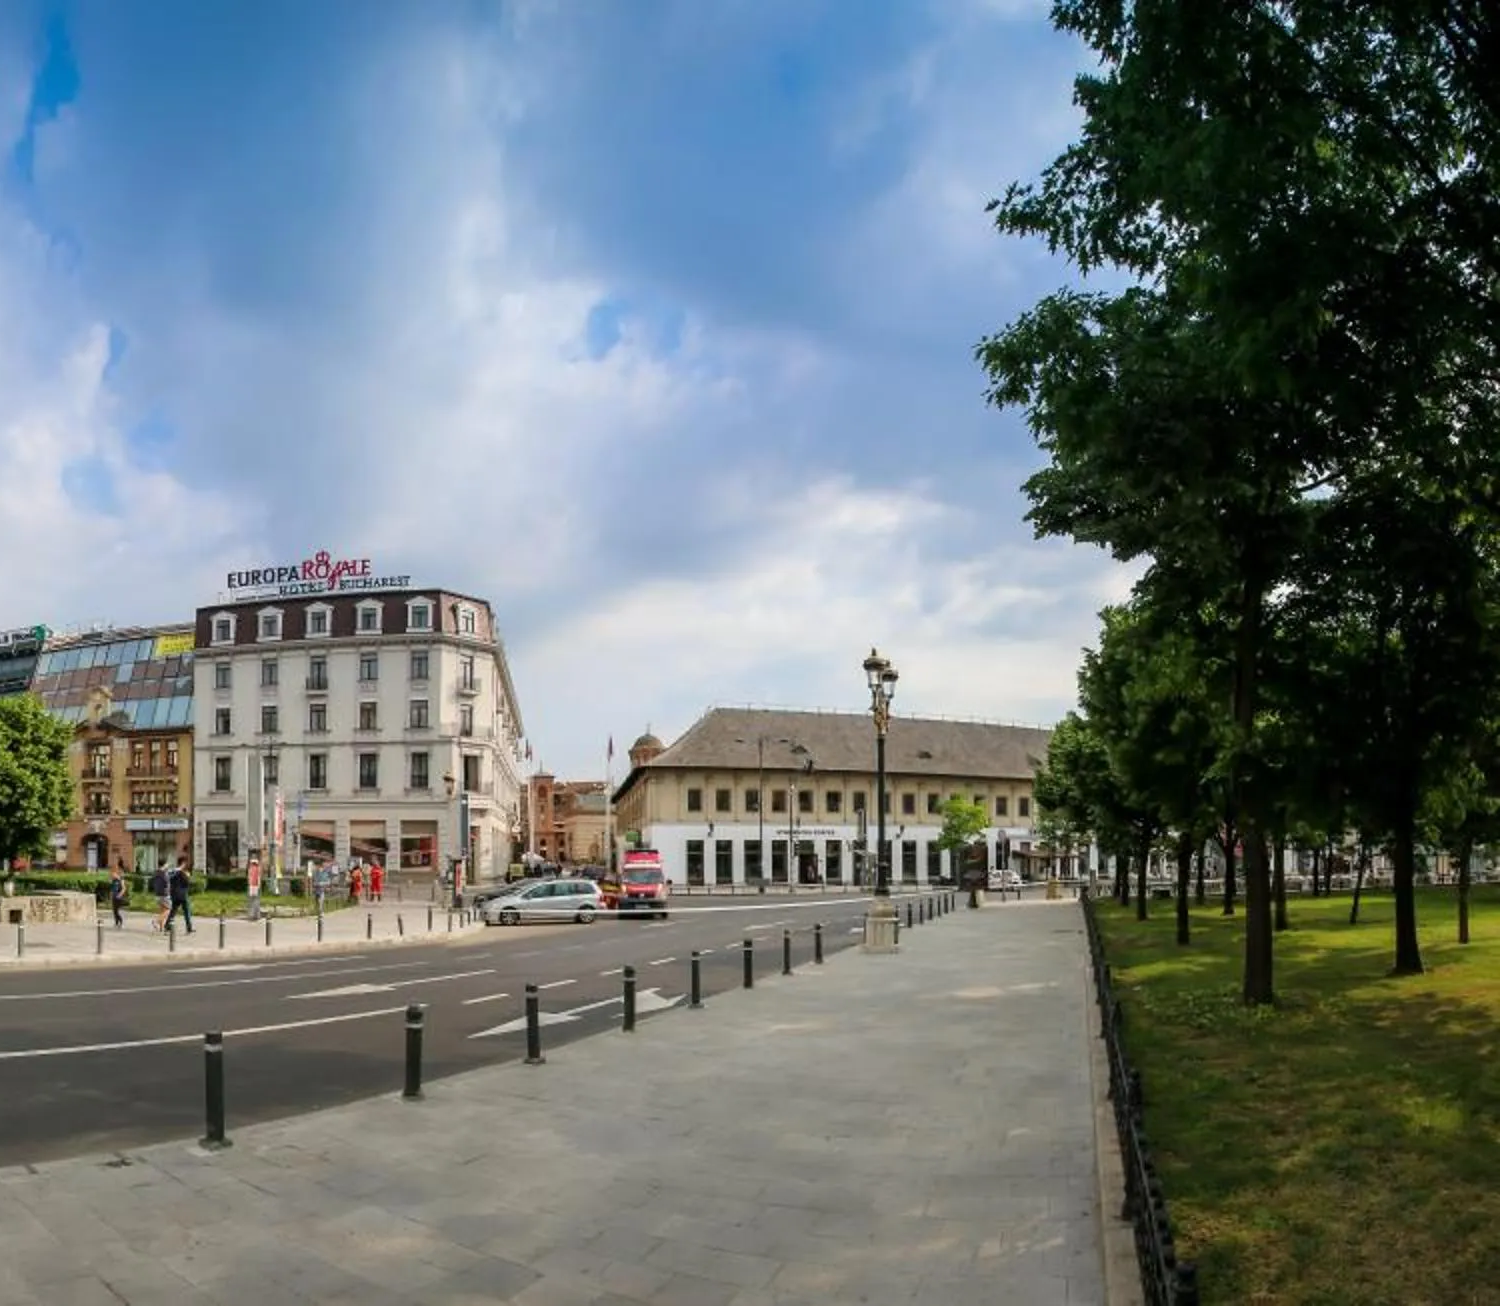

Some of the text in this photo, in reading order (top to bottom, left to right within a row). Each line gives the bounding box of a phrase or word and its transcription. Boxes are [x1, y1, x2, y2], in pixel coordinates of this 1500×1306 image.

[227, 566, 300, 589] EUROPA
[279, 576, 411, 596] HOTEL BUCHAREST
